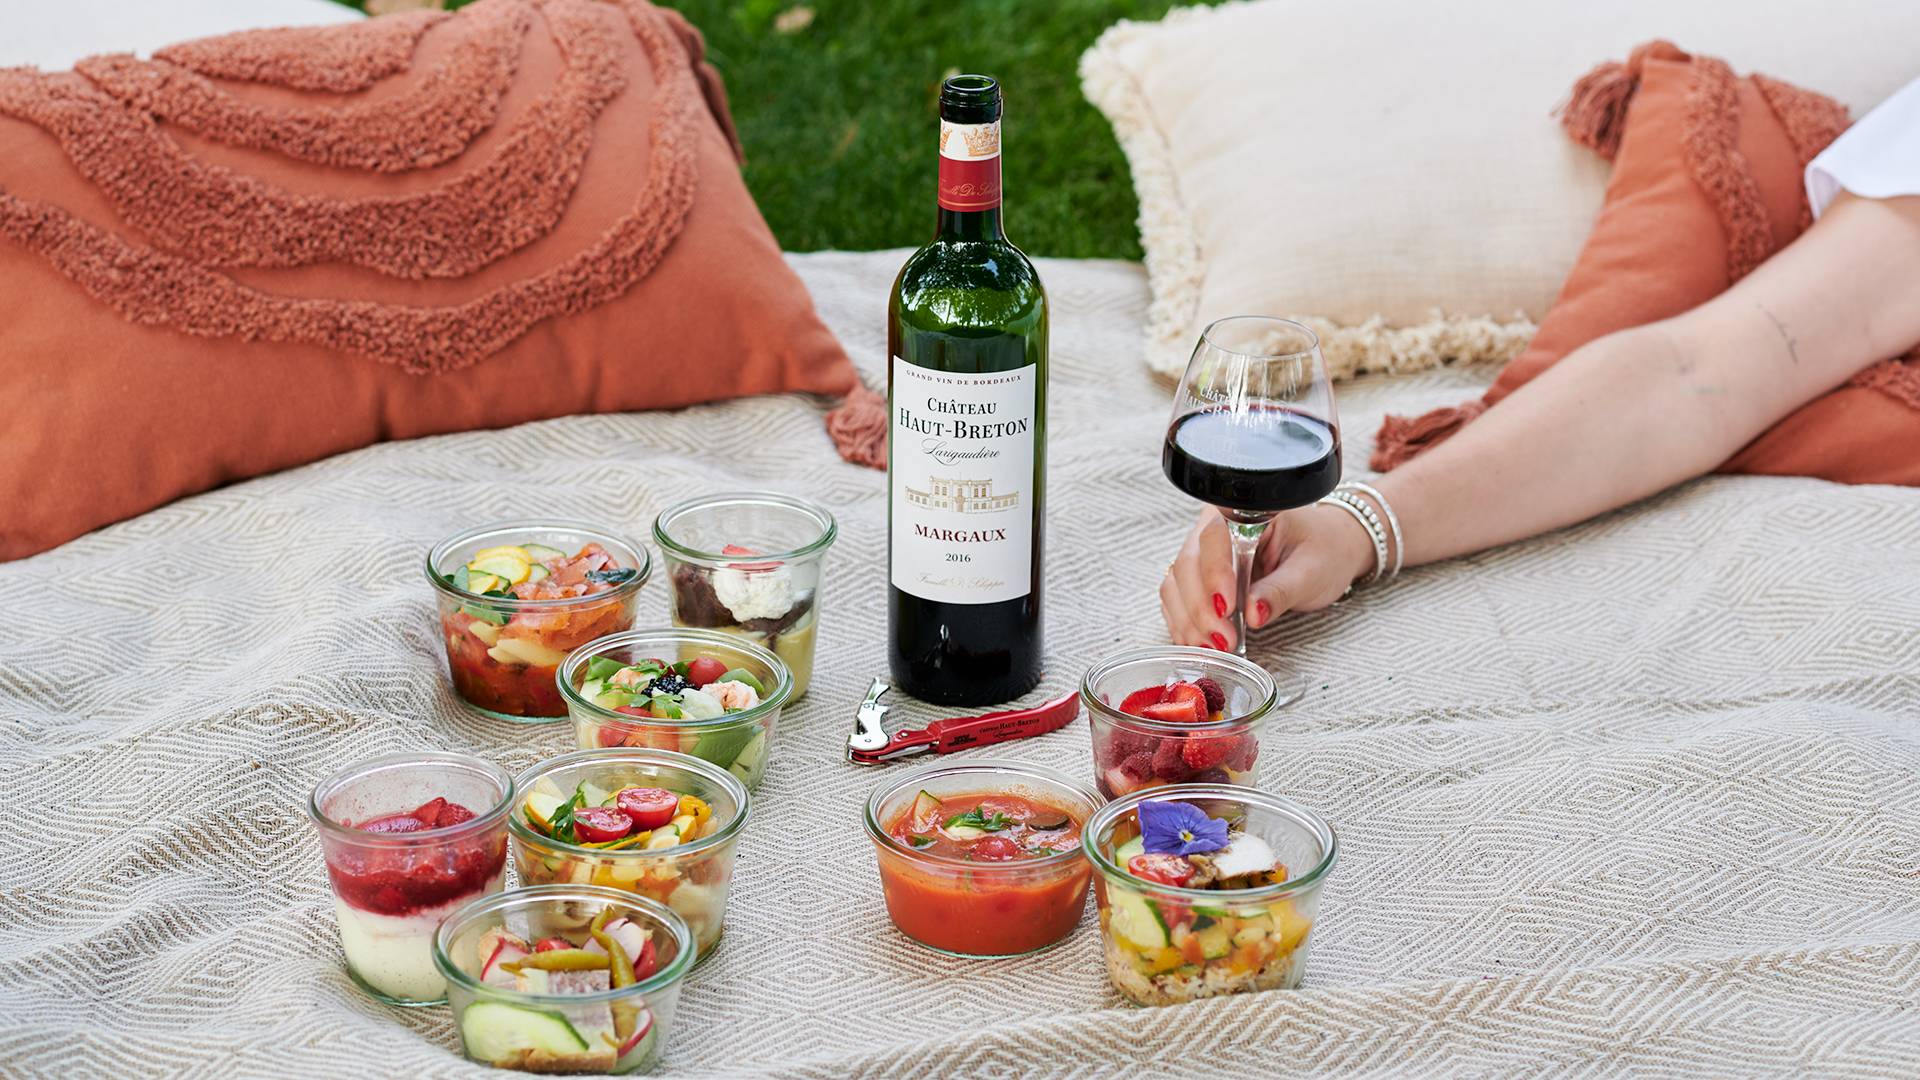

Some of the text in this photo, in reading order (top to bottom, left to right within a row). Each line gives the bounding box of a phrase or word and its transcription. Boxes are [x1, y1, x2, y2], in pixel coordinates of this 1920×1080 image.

[906, 369, 933, 381] GRAND
[973, 375, 1022, 385] BORDEAUX
[927, 397, 997, 415] CHÂTEAU
[900, 407, 1028, 439] HAUT-BRETON
[921, 438, 1000, 466] Larigaudière
[914, 523, 1007, 542] MARGAUX
[945, 553, 971, 562] 2016
